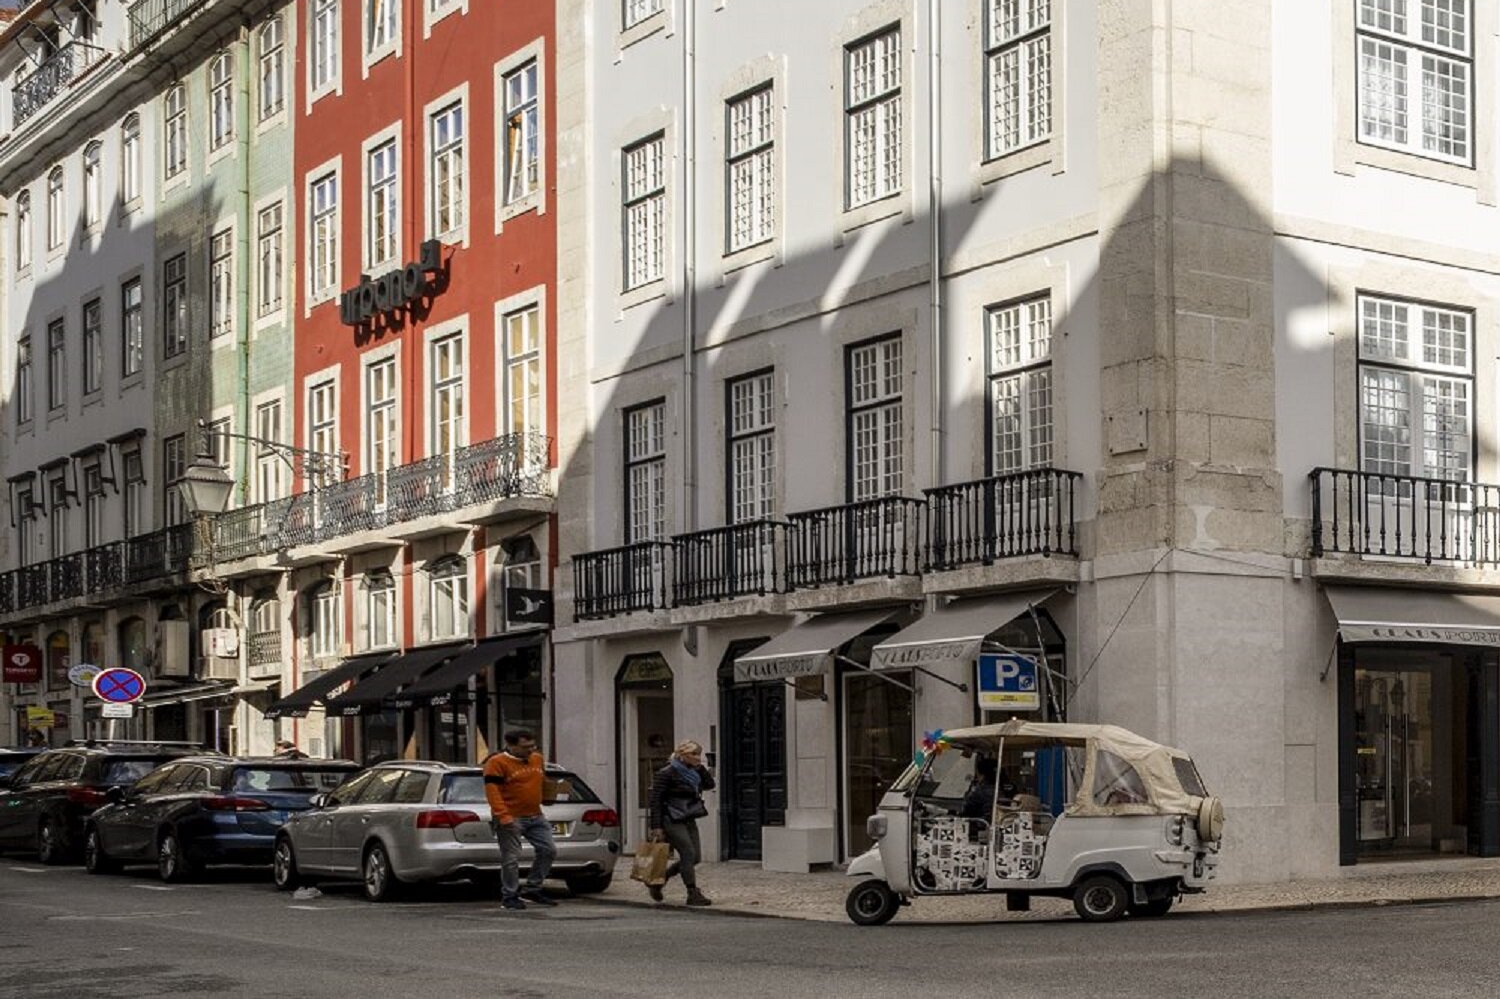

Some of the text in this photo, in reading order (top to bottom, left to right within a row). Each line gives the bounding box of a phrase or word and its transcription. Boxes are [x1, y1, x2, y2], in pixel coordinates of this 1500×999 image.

[1372, 628, 1441, 640] CLAUS
[779, 658, 814, 675] PORTO
[996, 659, 1020, 687] P
